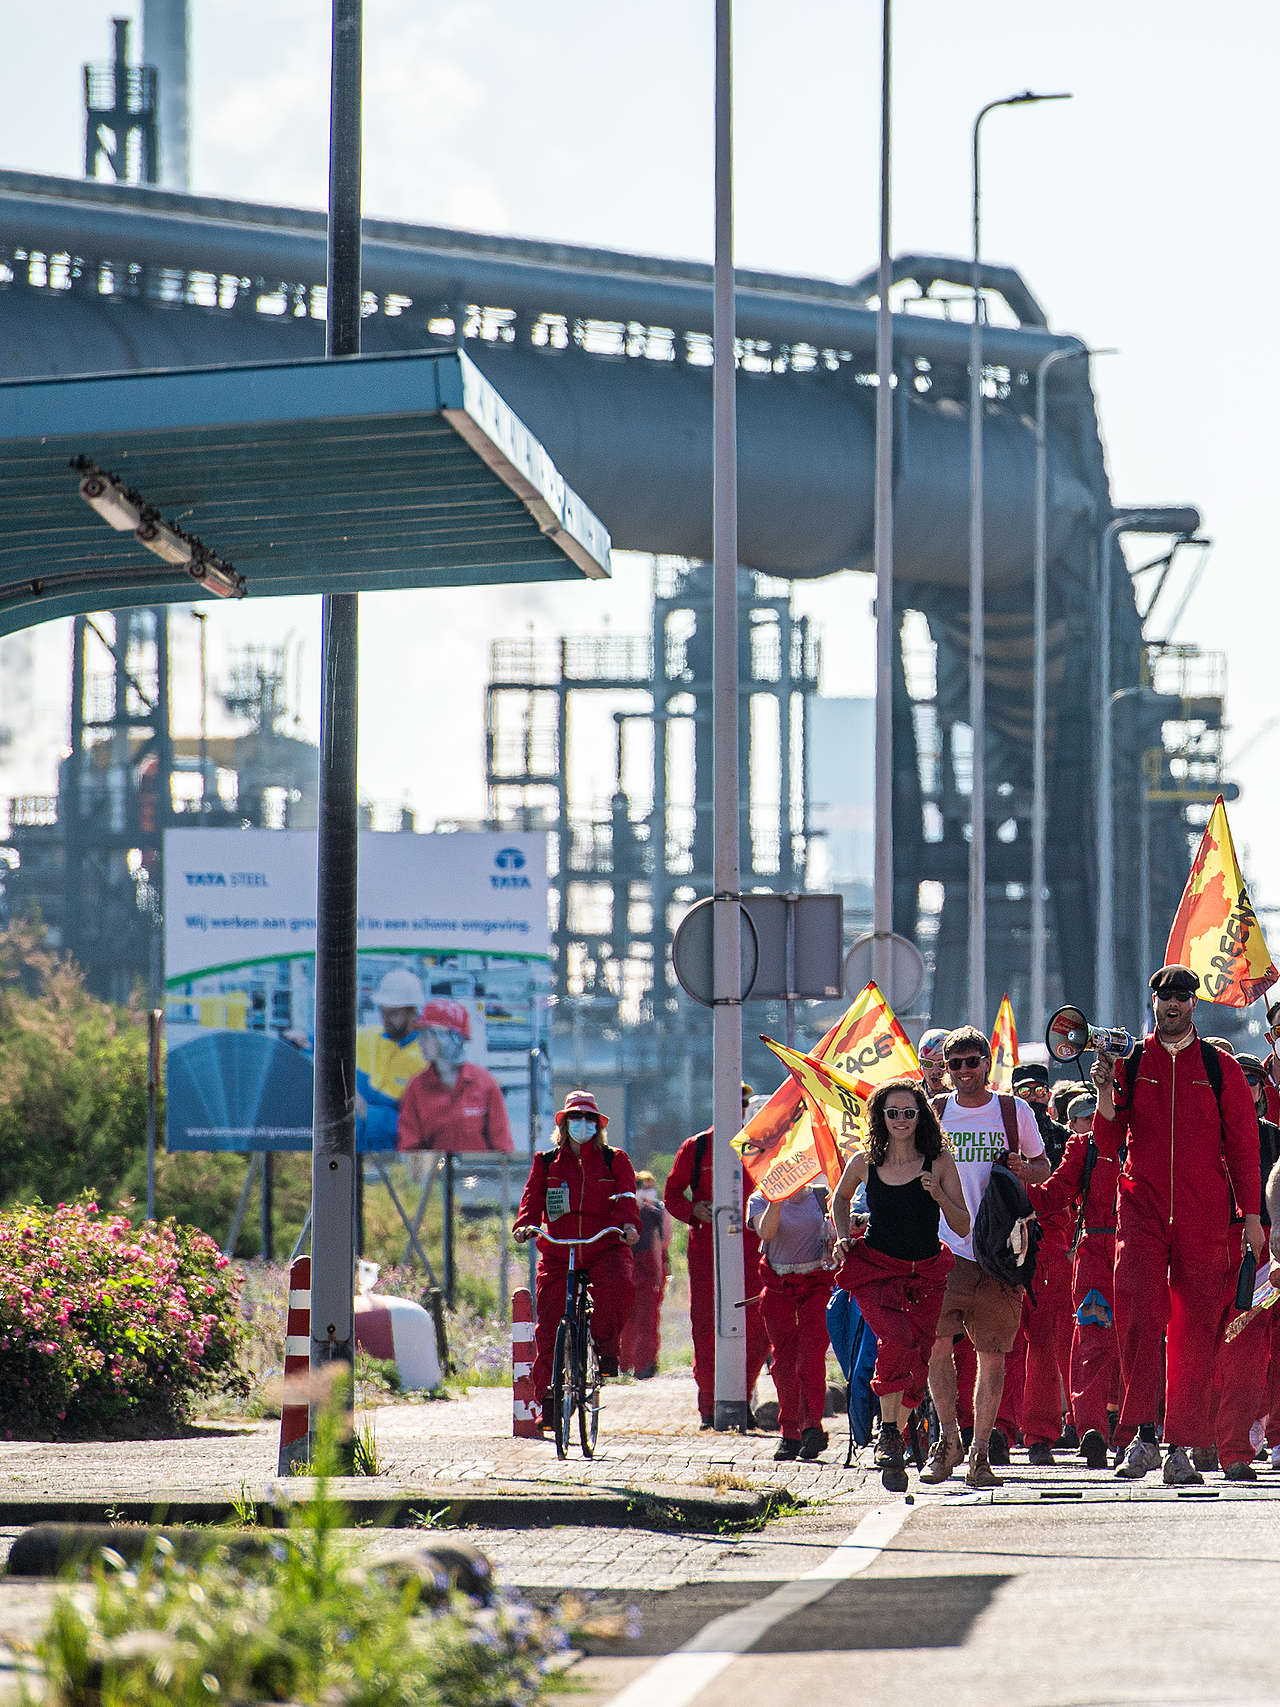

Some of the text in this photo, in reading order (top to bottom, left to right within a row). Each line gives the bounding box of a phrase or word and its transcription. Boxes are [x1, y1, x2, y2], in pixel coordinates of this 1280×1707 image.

[185, 872, 269, 888] TATA STEEL
[490, 875, 532, 889] TATA
[836, 1033, 893, 1074] ACE
[989, 1132, 1004, 1147] VS
[761, 1151, 806, 1188] PEOPLE VS
[768, 1157, 817, 1196] POLLUTERS
